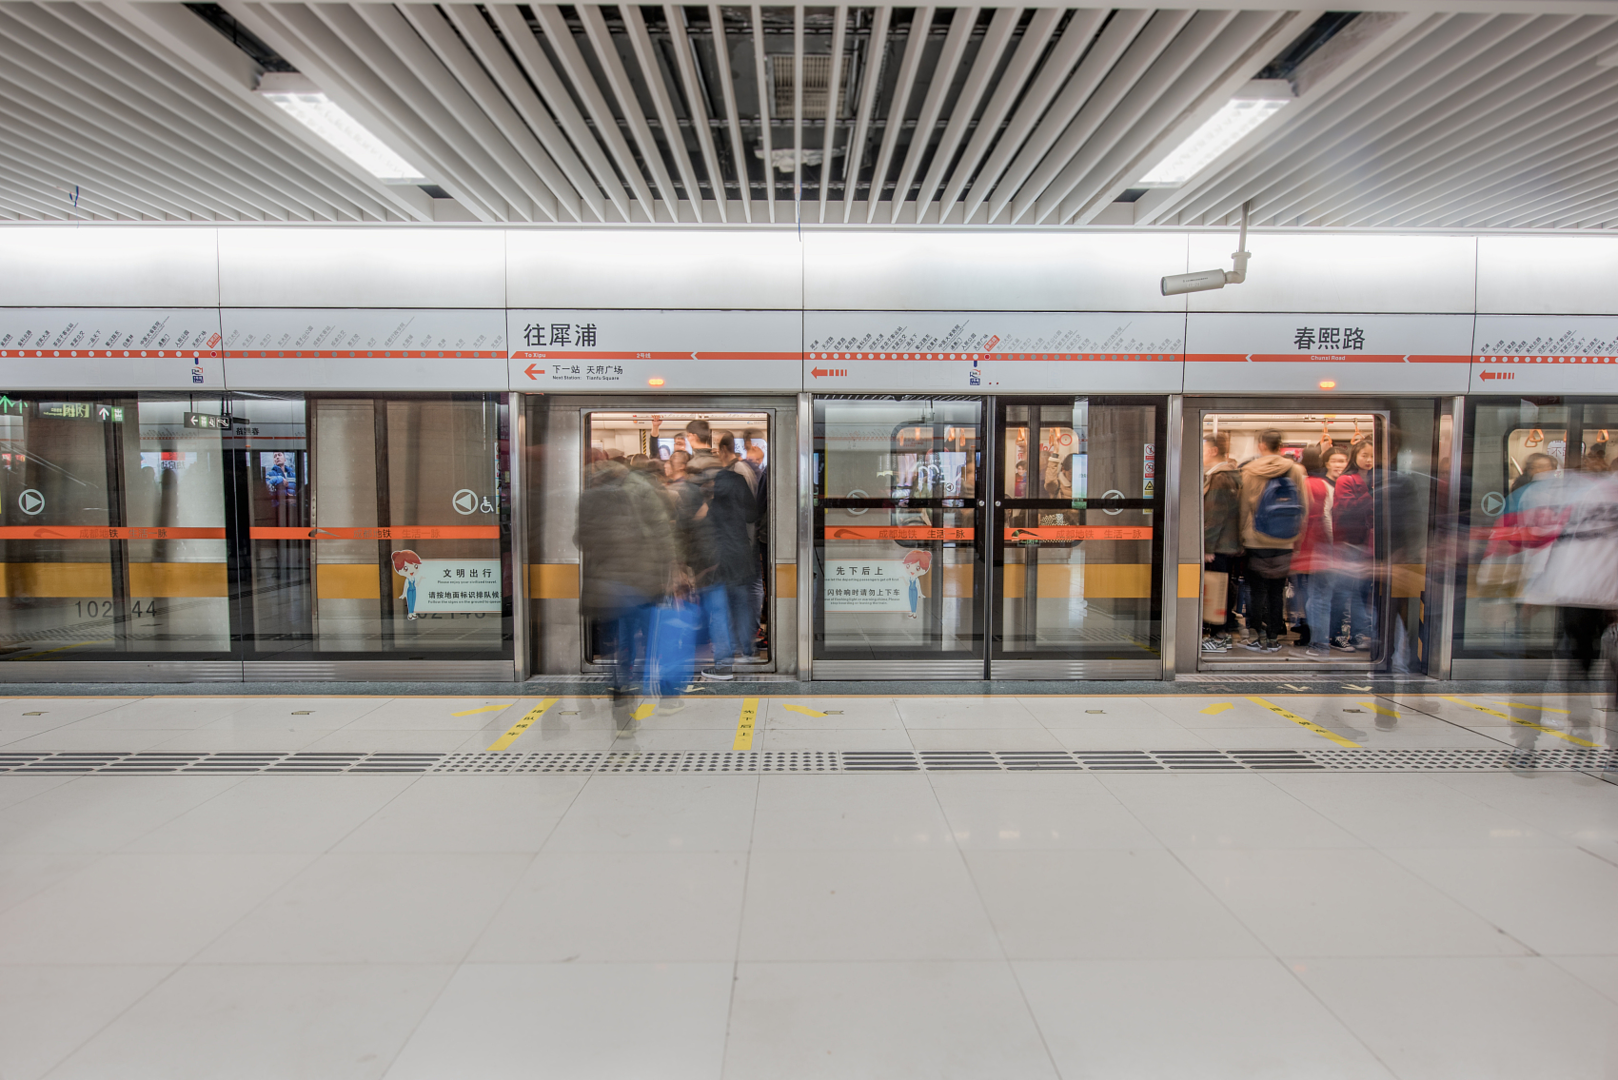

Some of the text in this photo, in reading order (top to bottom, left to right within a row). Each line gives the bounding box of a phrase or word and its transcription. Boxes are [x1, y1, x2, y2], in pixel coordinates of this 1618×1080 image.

[524, 323, 598, 347] 往犀浦
[1294, 326, 1365, 350] 春熙路
[552, 365, 623, 375] 下一站 天府广场
[79, 529, 168, 538] 成都地铁 生活一脉
[353, 529, 441, 538] 成都地铁 生活一脉
[878, 529, 965, 539] 成都地铁 生活一脉
[1056, 529, 1142, 539] 成都地铁 生活一脉
[443, 569, 492, 578] 文明出行
[836, 566, 883, 576] 先下后上
[428, 591, 502, 599] 请按地面标识排队候
[824, 588, 900, 596] 闪铃响时请勿上下车
[75, 600, 157, 618] 10244
